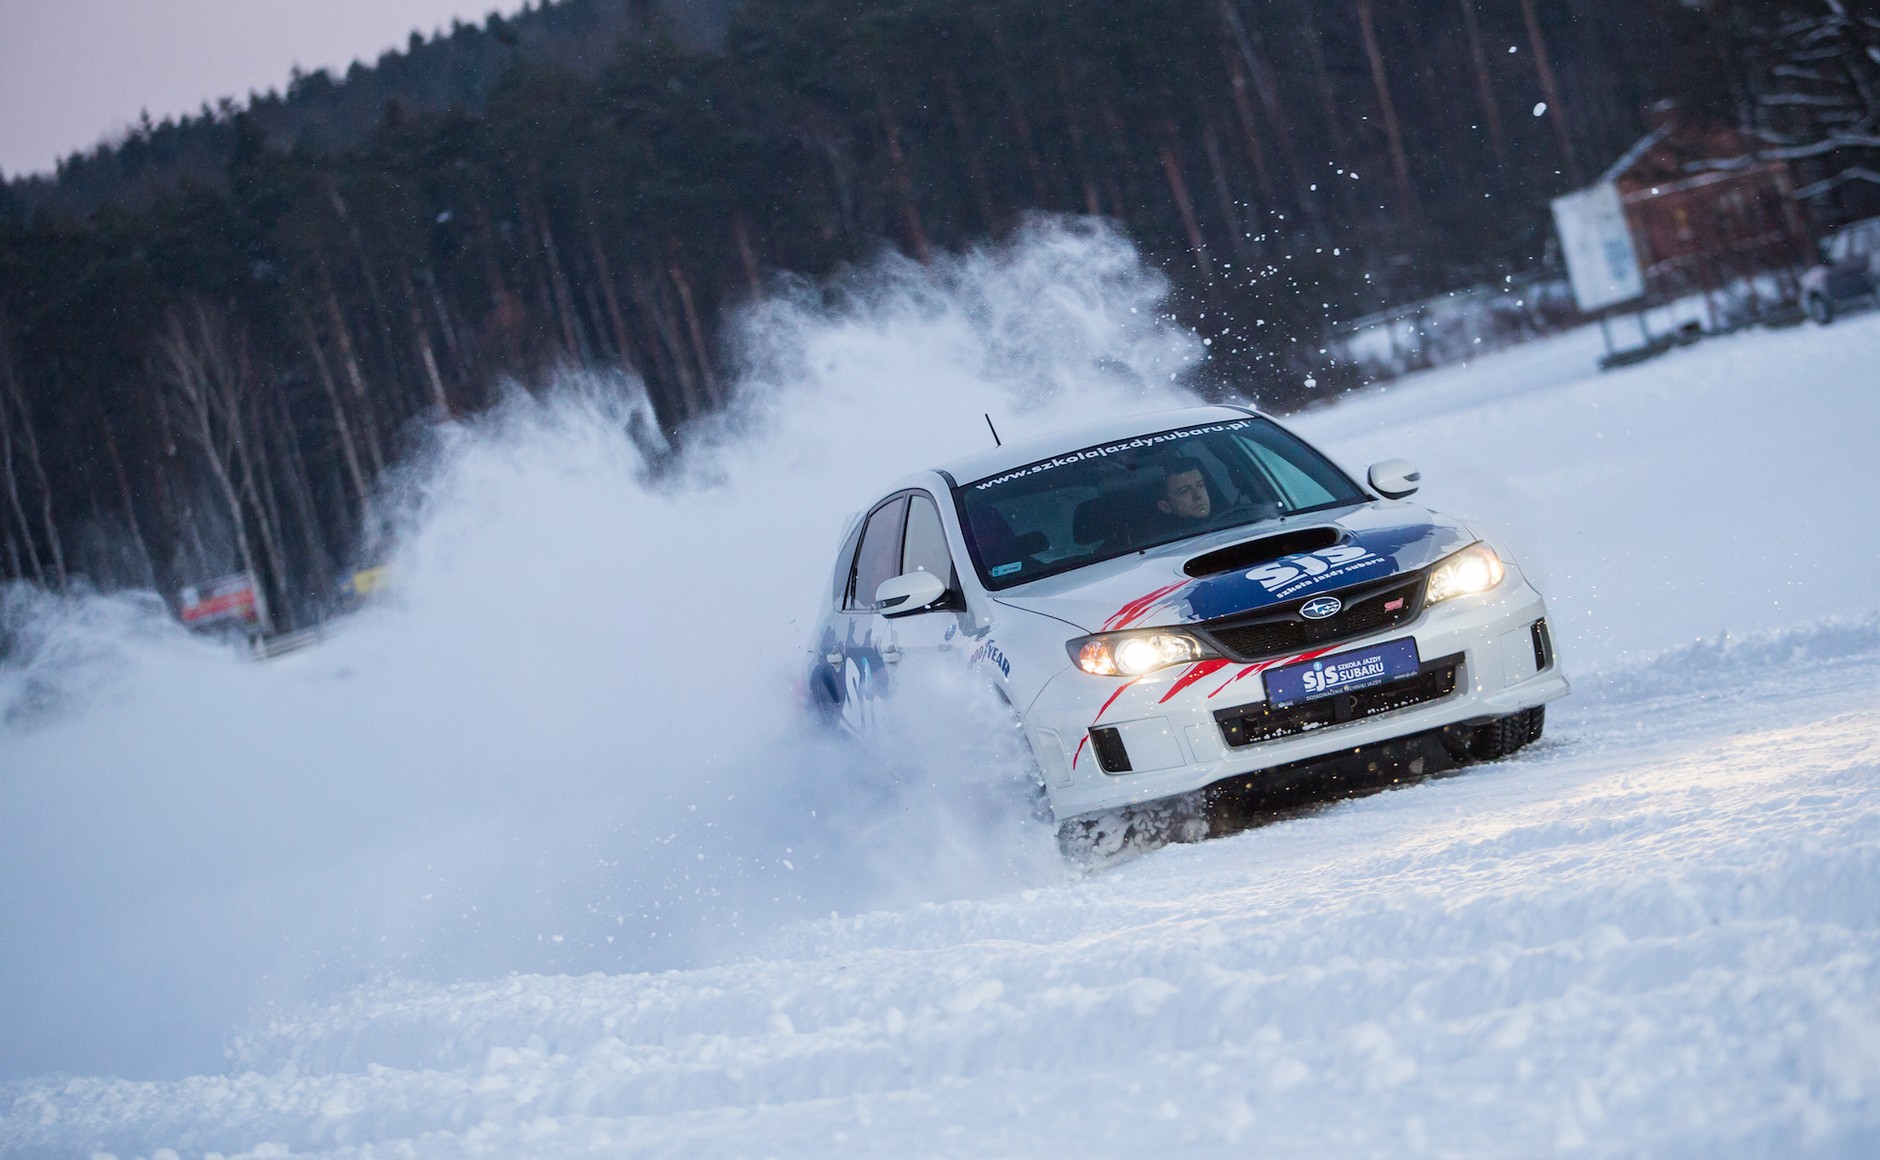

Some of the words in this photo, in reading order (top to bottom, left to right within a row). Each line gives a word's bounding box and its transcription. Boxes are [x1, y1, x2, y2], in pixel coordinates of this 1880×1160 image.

[976, 420, 1250, 491] www.szkolajazdysubaru.pl
[1313, 569, 1344, 583] jazdy
[1344, 557, 1385, 571] subaru
[1339, 662, 1384, 681] SUBARU
[1362, 655, 1382, 666] JAZDY
